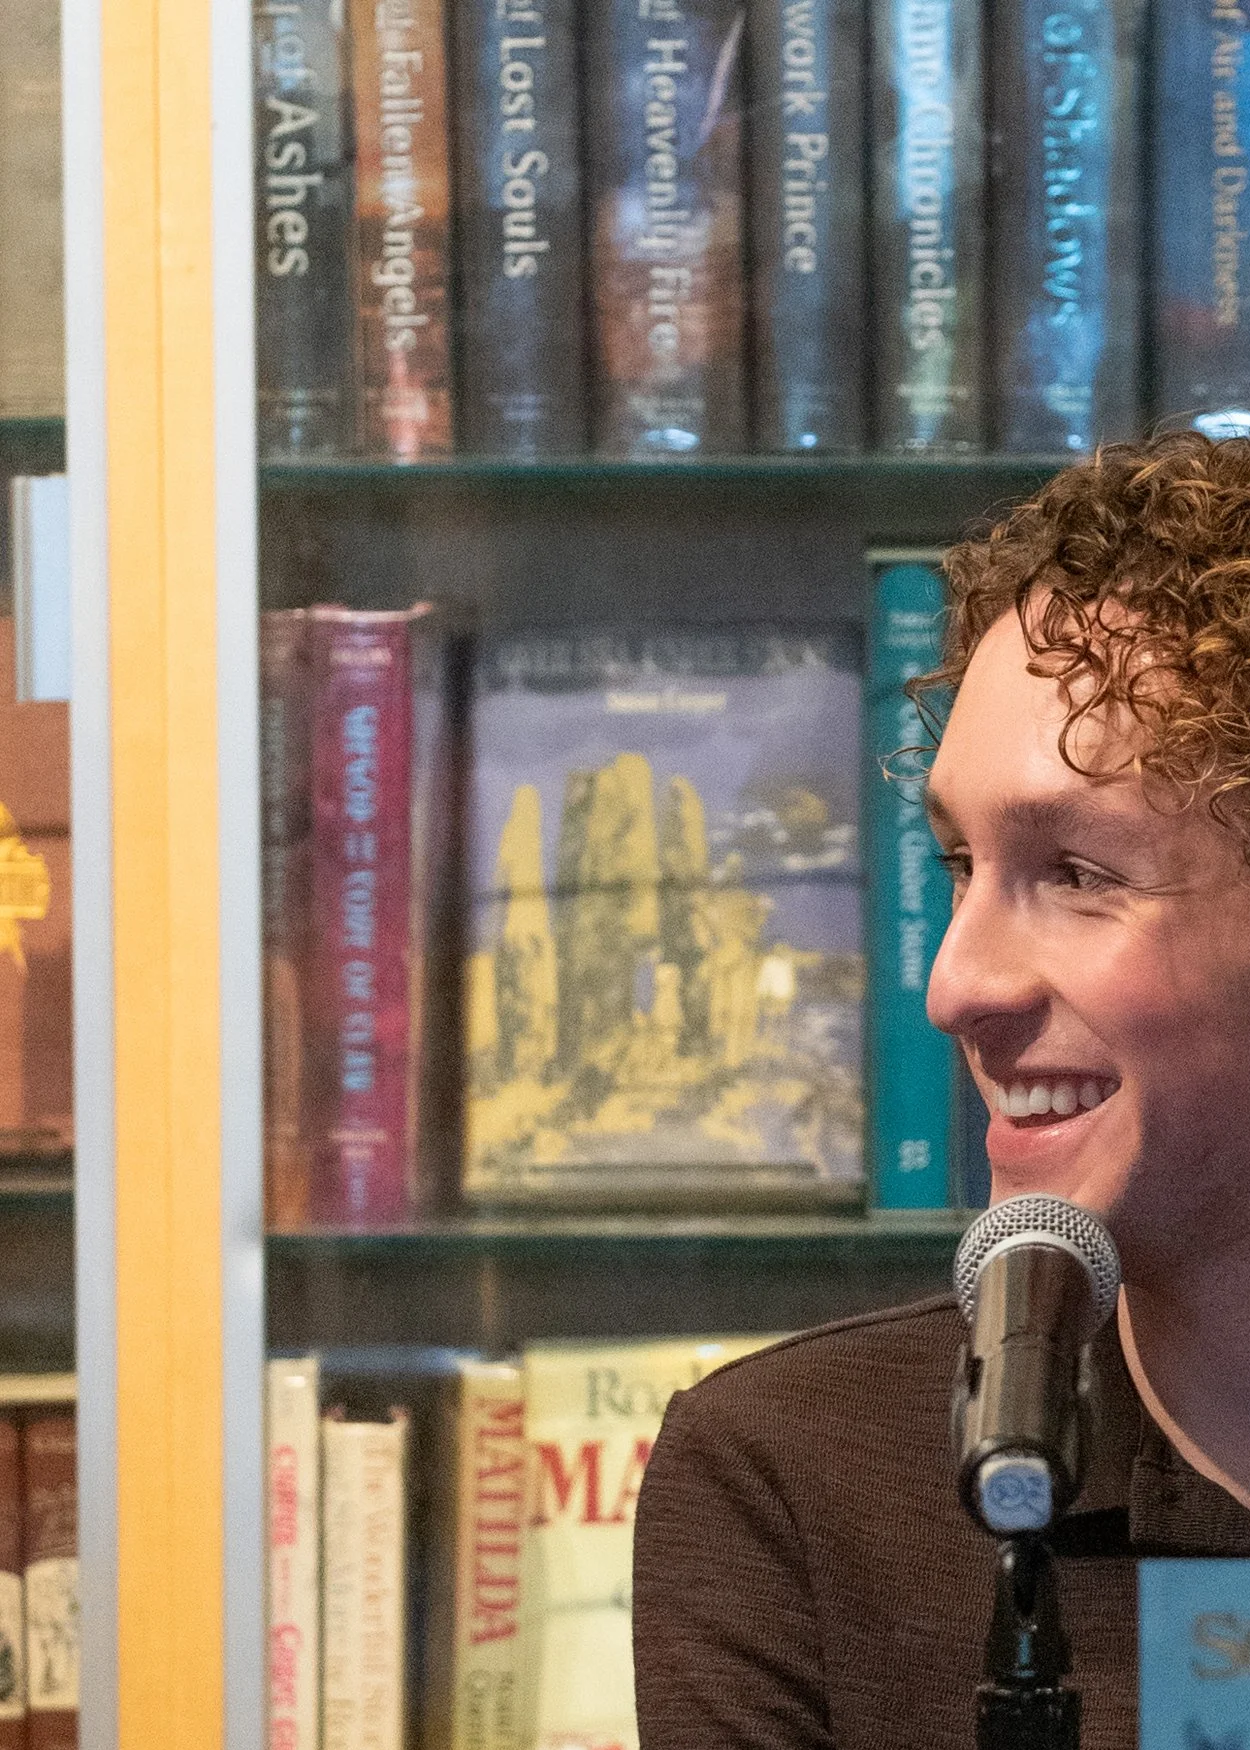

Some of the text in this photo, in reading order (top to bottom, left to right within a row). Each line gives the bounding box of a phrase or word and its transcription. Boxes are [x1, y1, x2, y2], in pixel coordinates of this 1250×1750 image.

[382, 50, 425, 180] Fallen
[499, 36, 548, 133] Lost
[1211, 32, 1246, 79] Air
[1213, 90, 1248, 156] and
[265, 97, 324, 278] Ashes
[502, 150, 552, 279] Souls
[640, 37, 690, 250] Heavenly
[785, 131, 830, 275] Prince
[373, 198, 428, 351] Angels
[909, 100, 957, 351] Chronicles
[1212, 166, 1250, 327] Darkness
[648, 265, 692, 354] Fire
[472, 1394, 525, 1646] MATILDA
